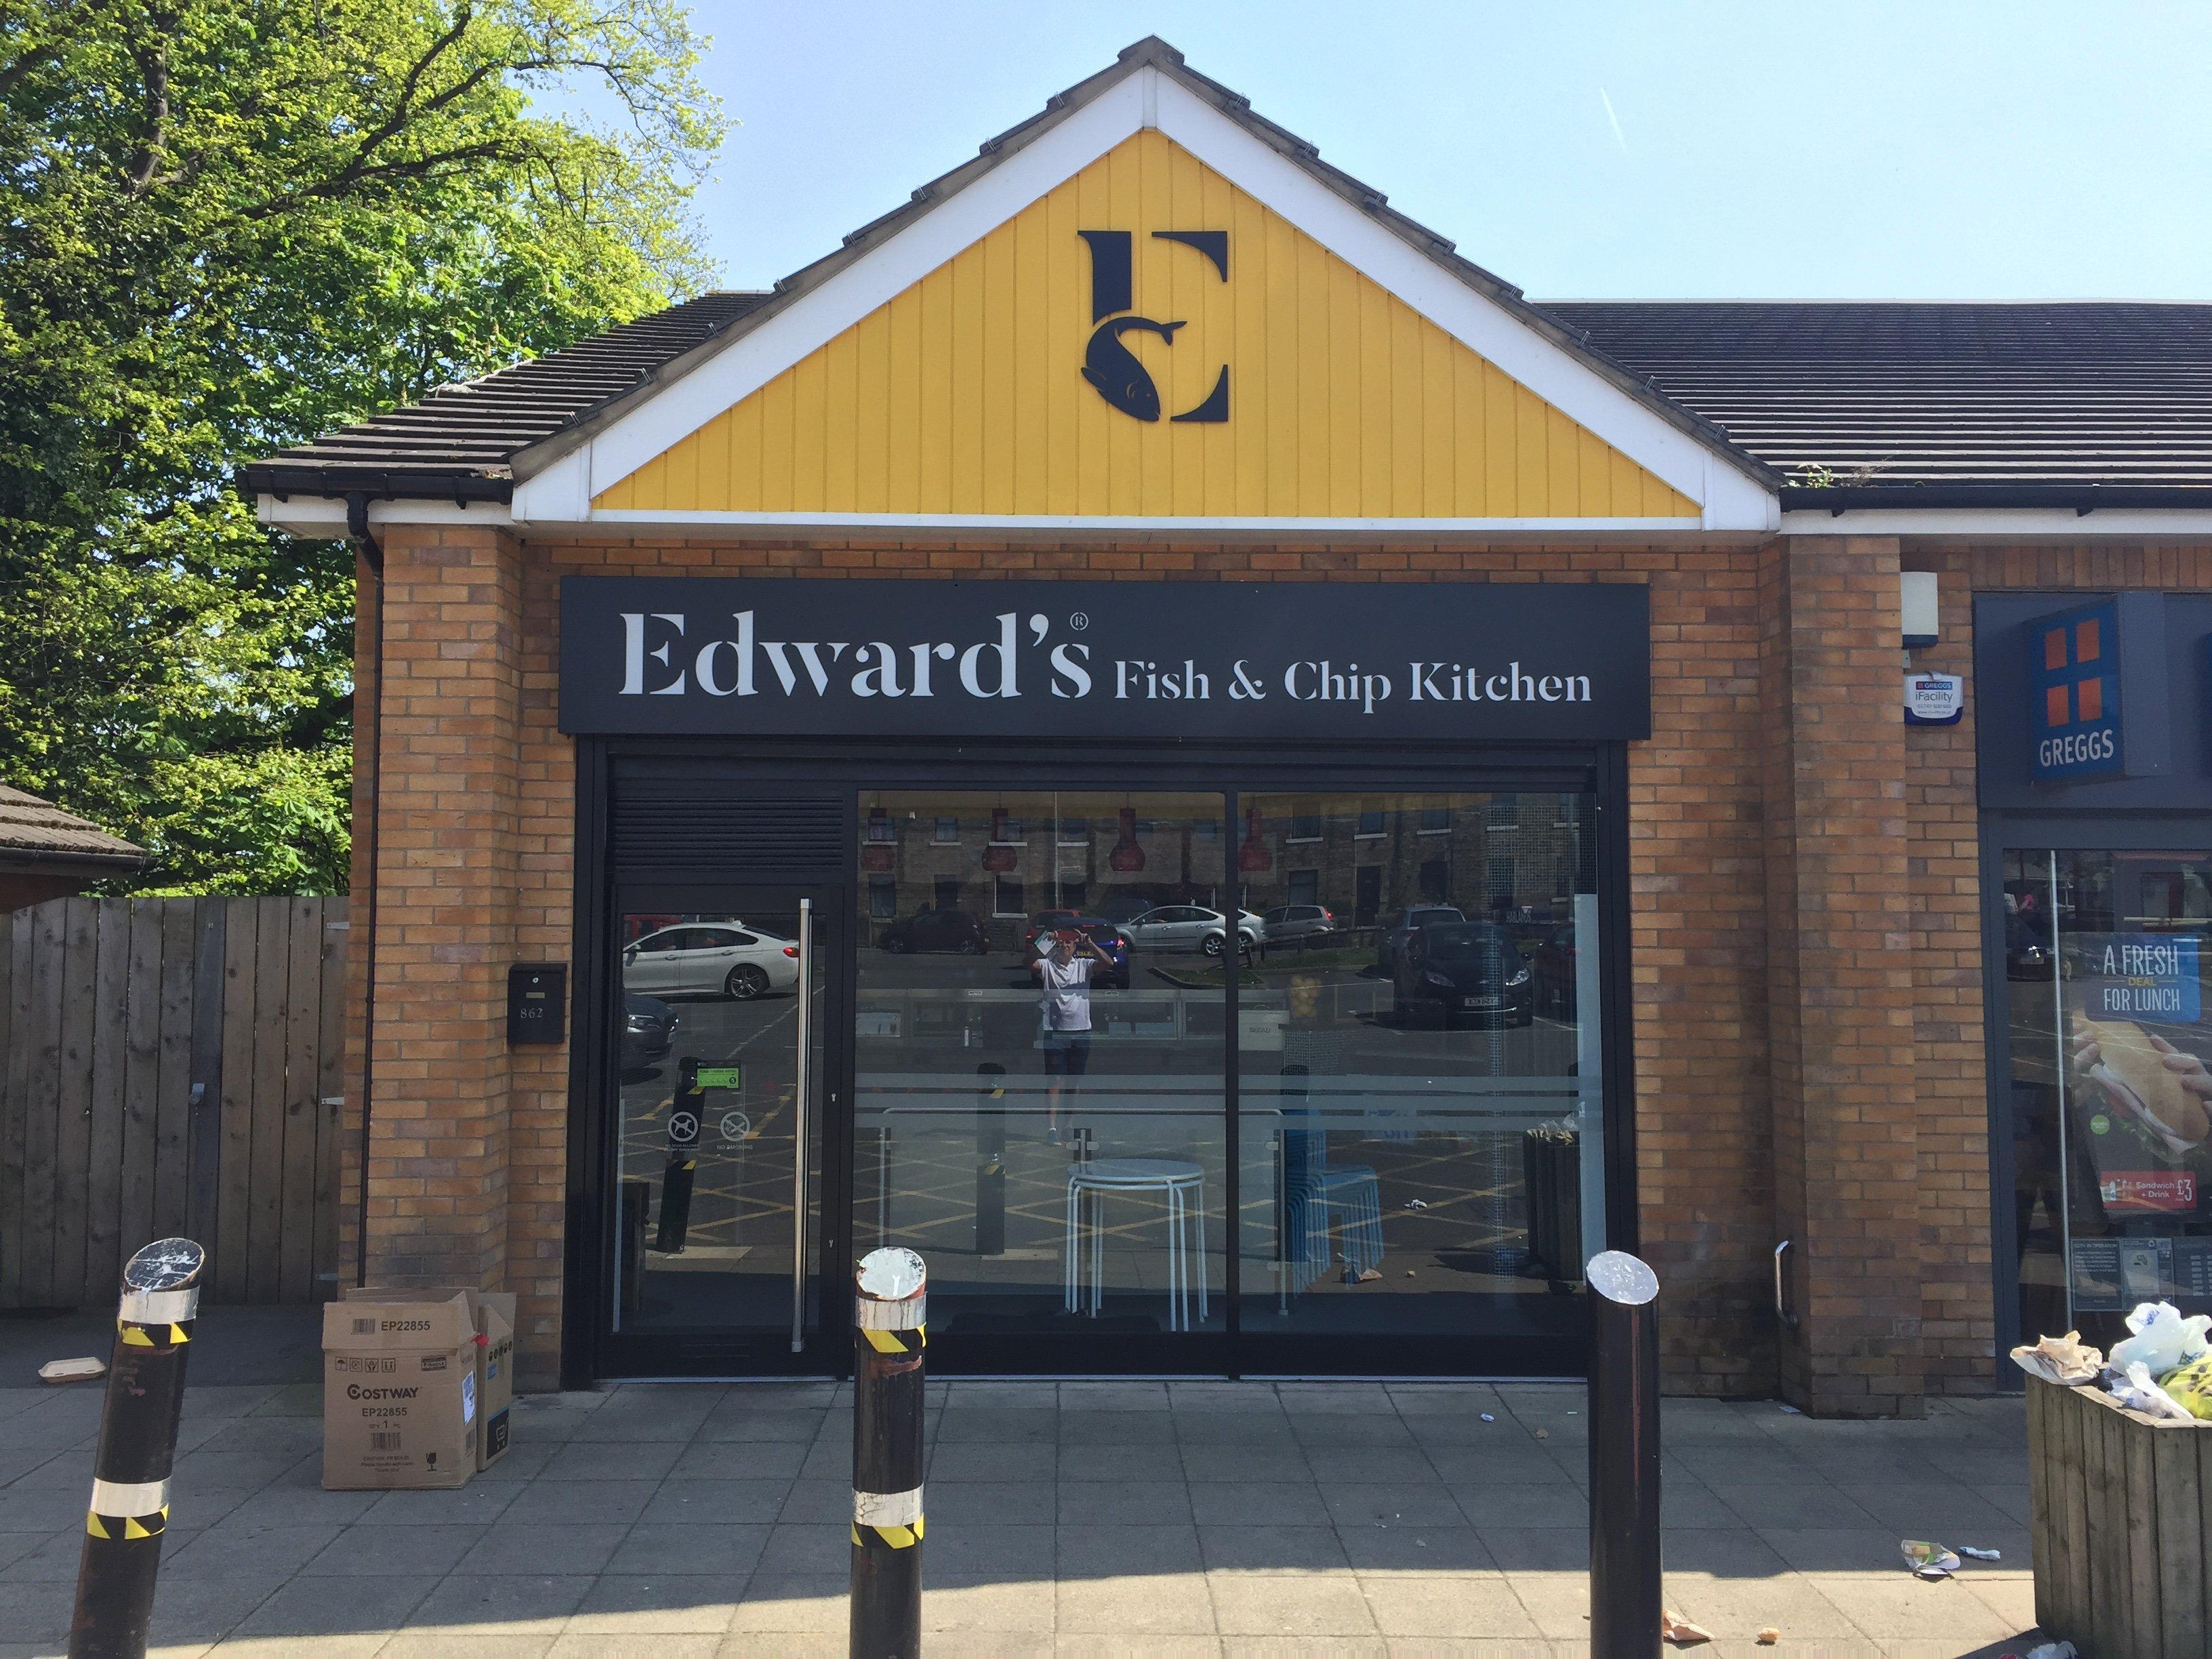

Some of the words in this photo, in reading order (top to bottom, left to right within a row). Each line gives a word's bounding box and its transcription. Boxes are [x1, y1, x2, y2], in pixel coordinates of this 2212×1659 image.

[619, 610, 1092, 698] Edward's
[1114, 659, 1210, 700] Fish
[1228, 660, 1267, 701] &
[1284, 661, 1391, 714] Chip
[1409, 661, 1592, 702] Kitchen
[1915, 691, 1953, 703] iFacility
[2040, 729, 2114, 767] GREGGS
[2104, 945, 2116, 975] A
[2122, 945, 2179, 976] FRESH
[2104, 989, 2131, 1012] FOR
[2135, 989, 2180, 1012] LUNCH
[2136, 1181, 2175, 1189] Sandwich
[2177, 1179, 2192, 1202] £3
[381, 1321, 430, 1332] EP22855
[347, 1384, 419, 1400] COSTWAY
[362, 1407, 408, 1417] EP22855
